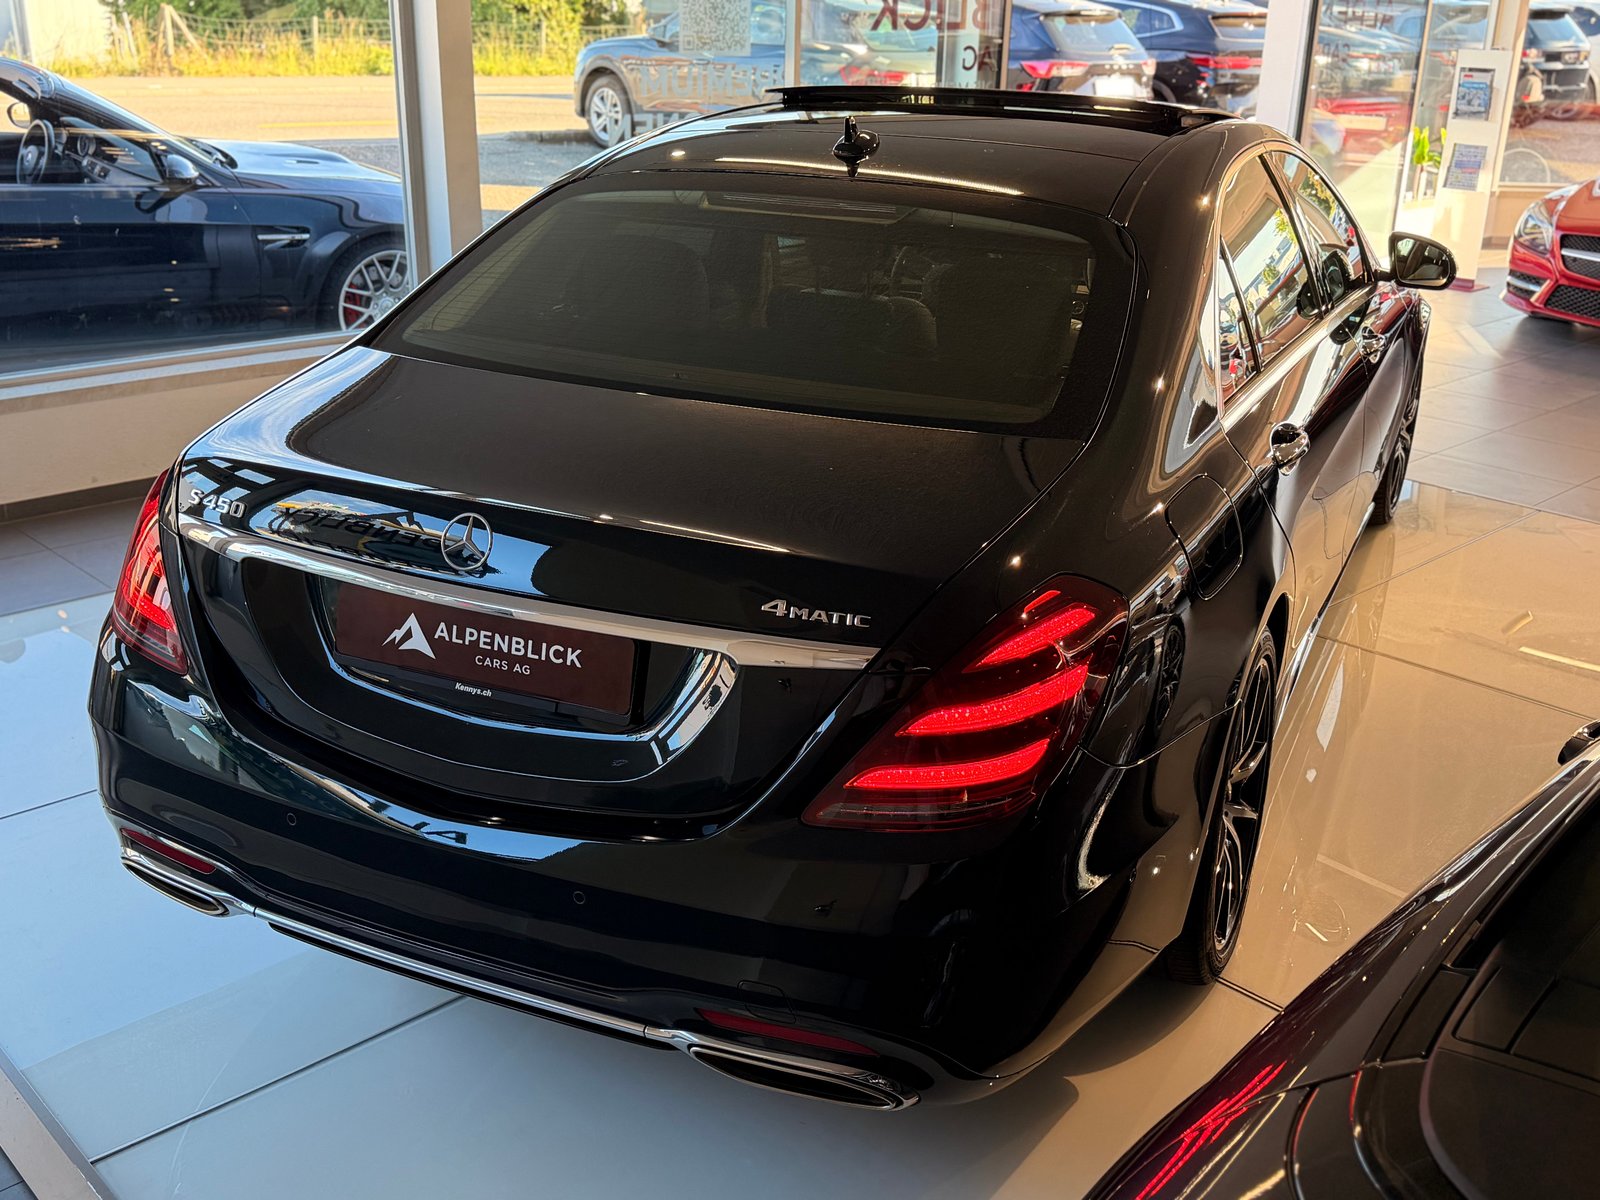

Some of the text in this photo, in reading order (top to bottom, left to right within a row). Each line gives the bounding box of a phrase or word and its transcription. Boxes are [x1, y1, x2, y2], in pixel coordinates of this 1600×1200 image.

[760, 599, 872, 628] 4MATIC
[433, 621, 582, 669] ALPENBLICK
[475, 655, 531, 675] CARS AG
[455, 682, 492, 697] Kennys.ch
